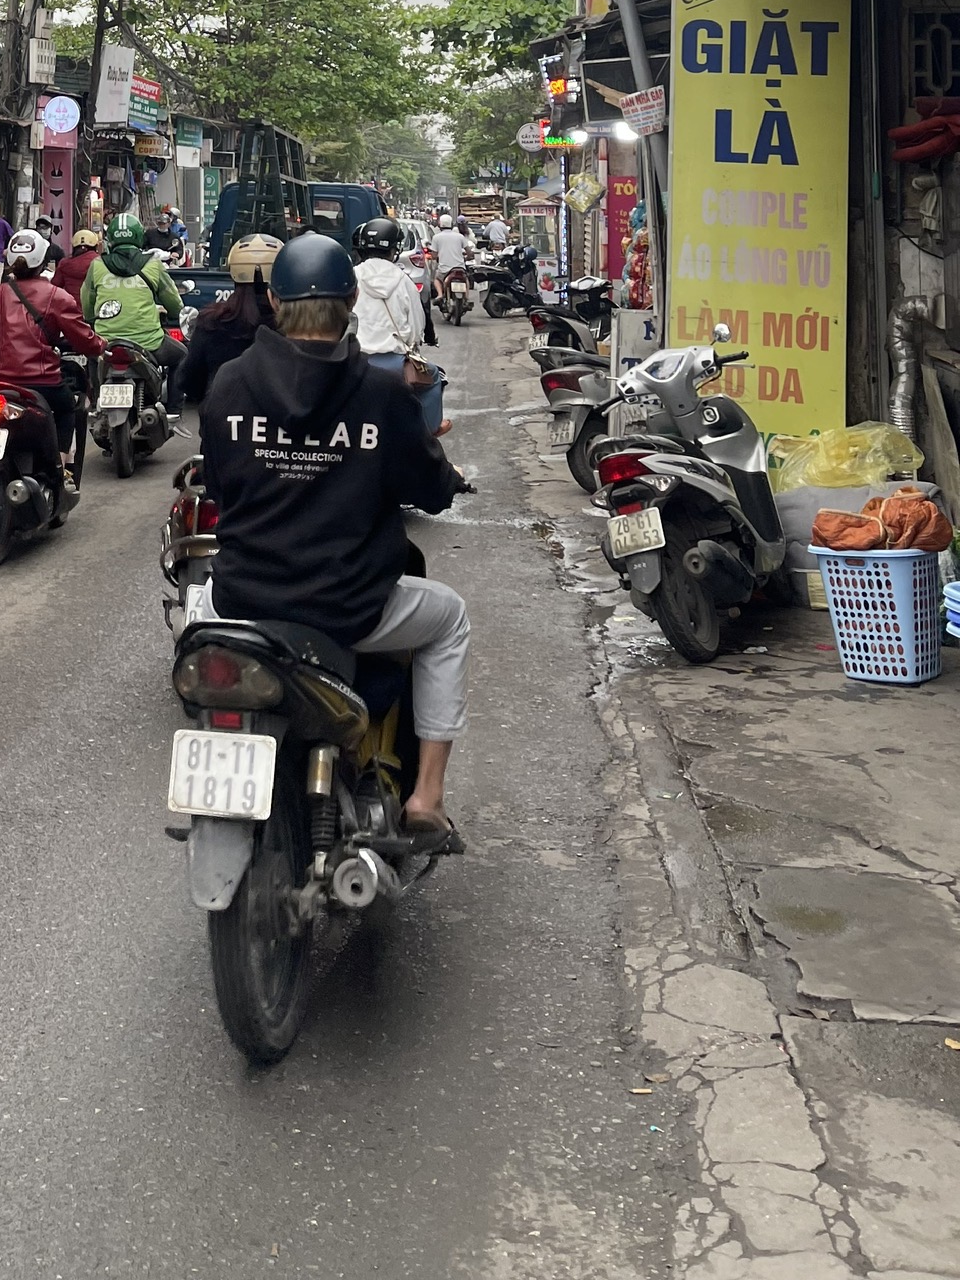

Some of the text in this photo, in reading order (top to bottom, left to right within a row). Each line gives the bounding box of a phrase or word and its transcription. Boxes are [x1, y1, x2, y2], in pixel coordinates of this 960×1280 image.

[681, 8, 840, 88] GIẶT
[136, 136, 162, 145] PHOTO
[139, 146, 160, 154] COPY
[714, 97, 799, 166] LÀ
[701, 188, 808, 230] COMPLE
[113, 229, 133, 238] Grab
[677, 234, 711, 282] ÁO
[797, 243, 831, 289] VŨ
[677, 299, 749, 346] LÀM
[762, 307, 830, 352] MỚI
[758, 365, 804, 405] DA
[227, 415, 379, 450] TELLAB
[254, 448, 343, 462] SPECIAL COLLECTION
[187, 738, 256, 775] 81-T1
[185, 775, 257, 812] 1819
